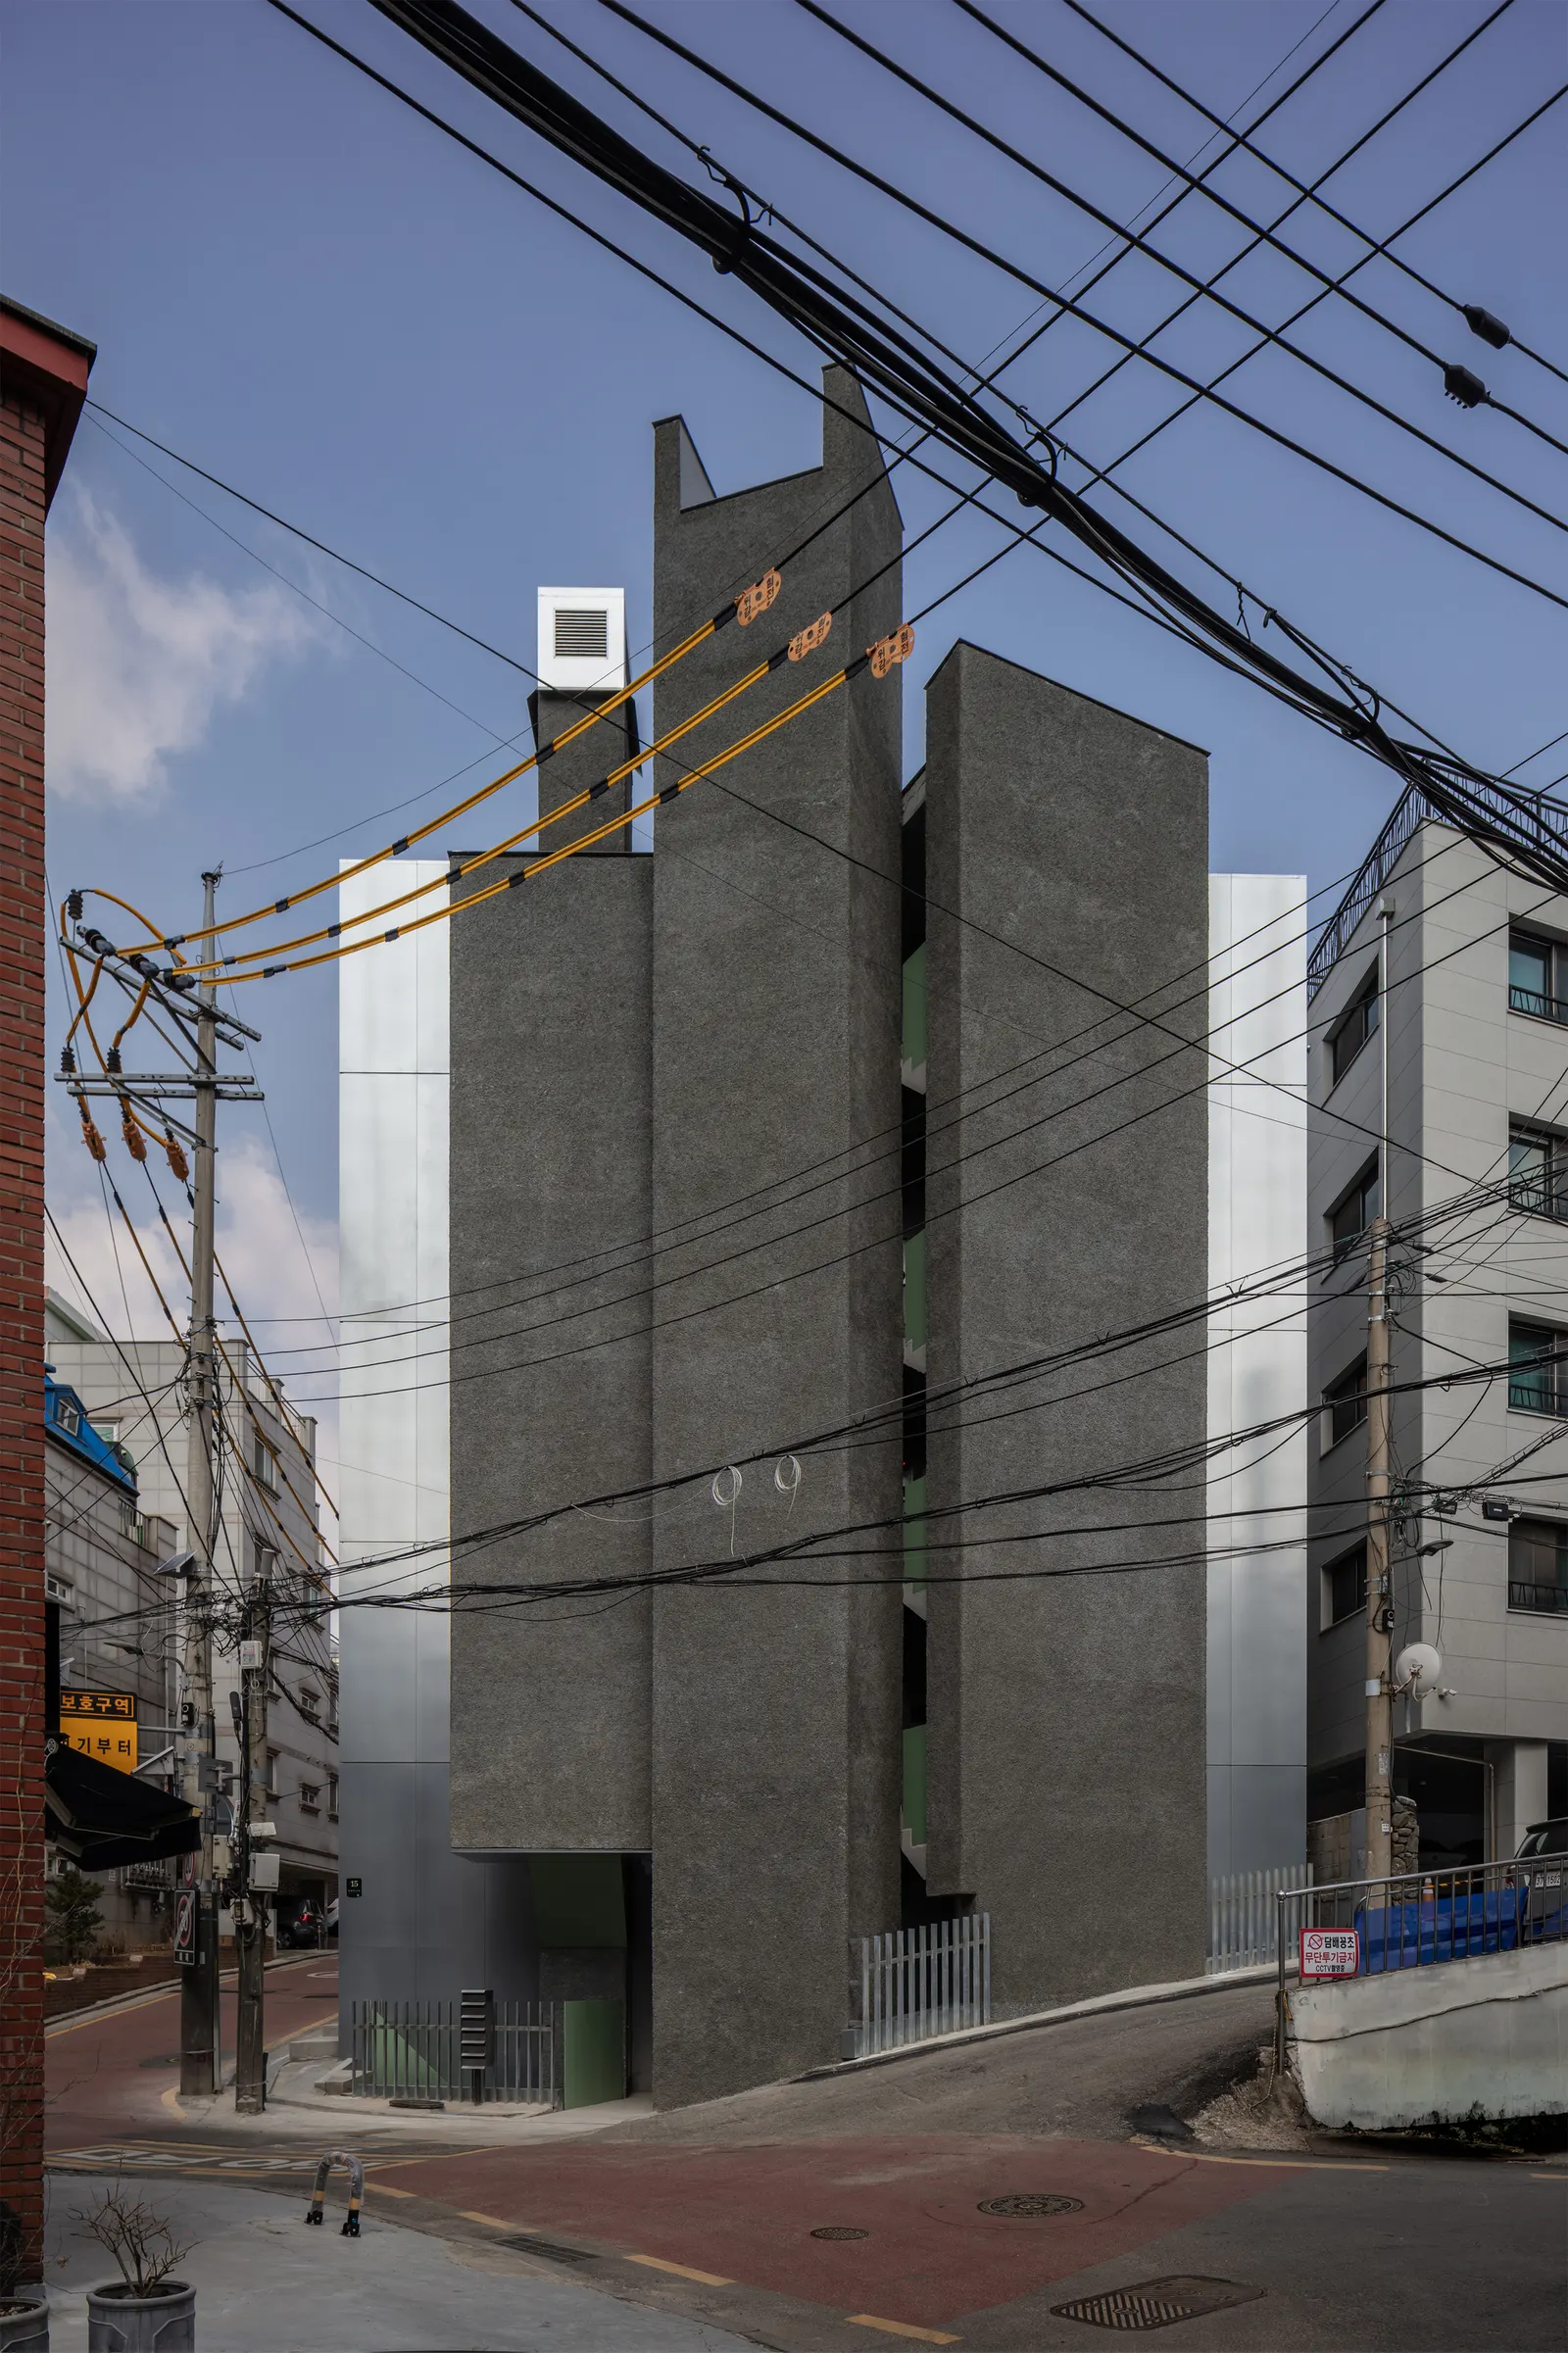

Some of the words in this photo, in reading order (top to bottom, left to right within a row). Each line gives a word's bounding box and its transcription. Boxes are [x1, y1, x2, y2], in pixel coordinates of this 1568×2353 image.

[61, 1694, 128, 1714] 보호구역
[64, 1737, 131, 1756] 기부터
[1324, 1936, 1354, 1948] 담배꽁초
[1305, 1951, 1354, 1963] 무단투기금지
